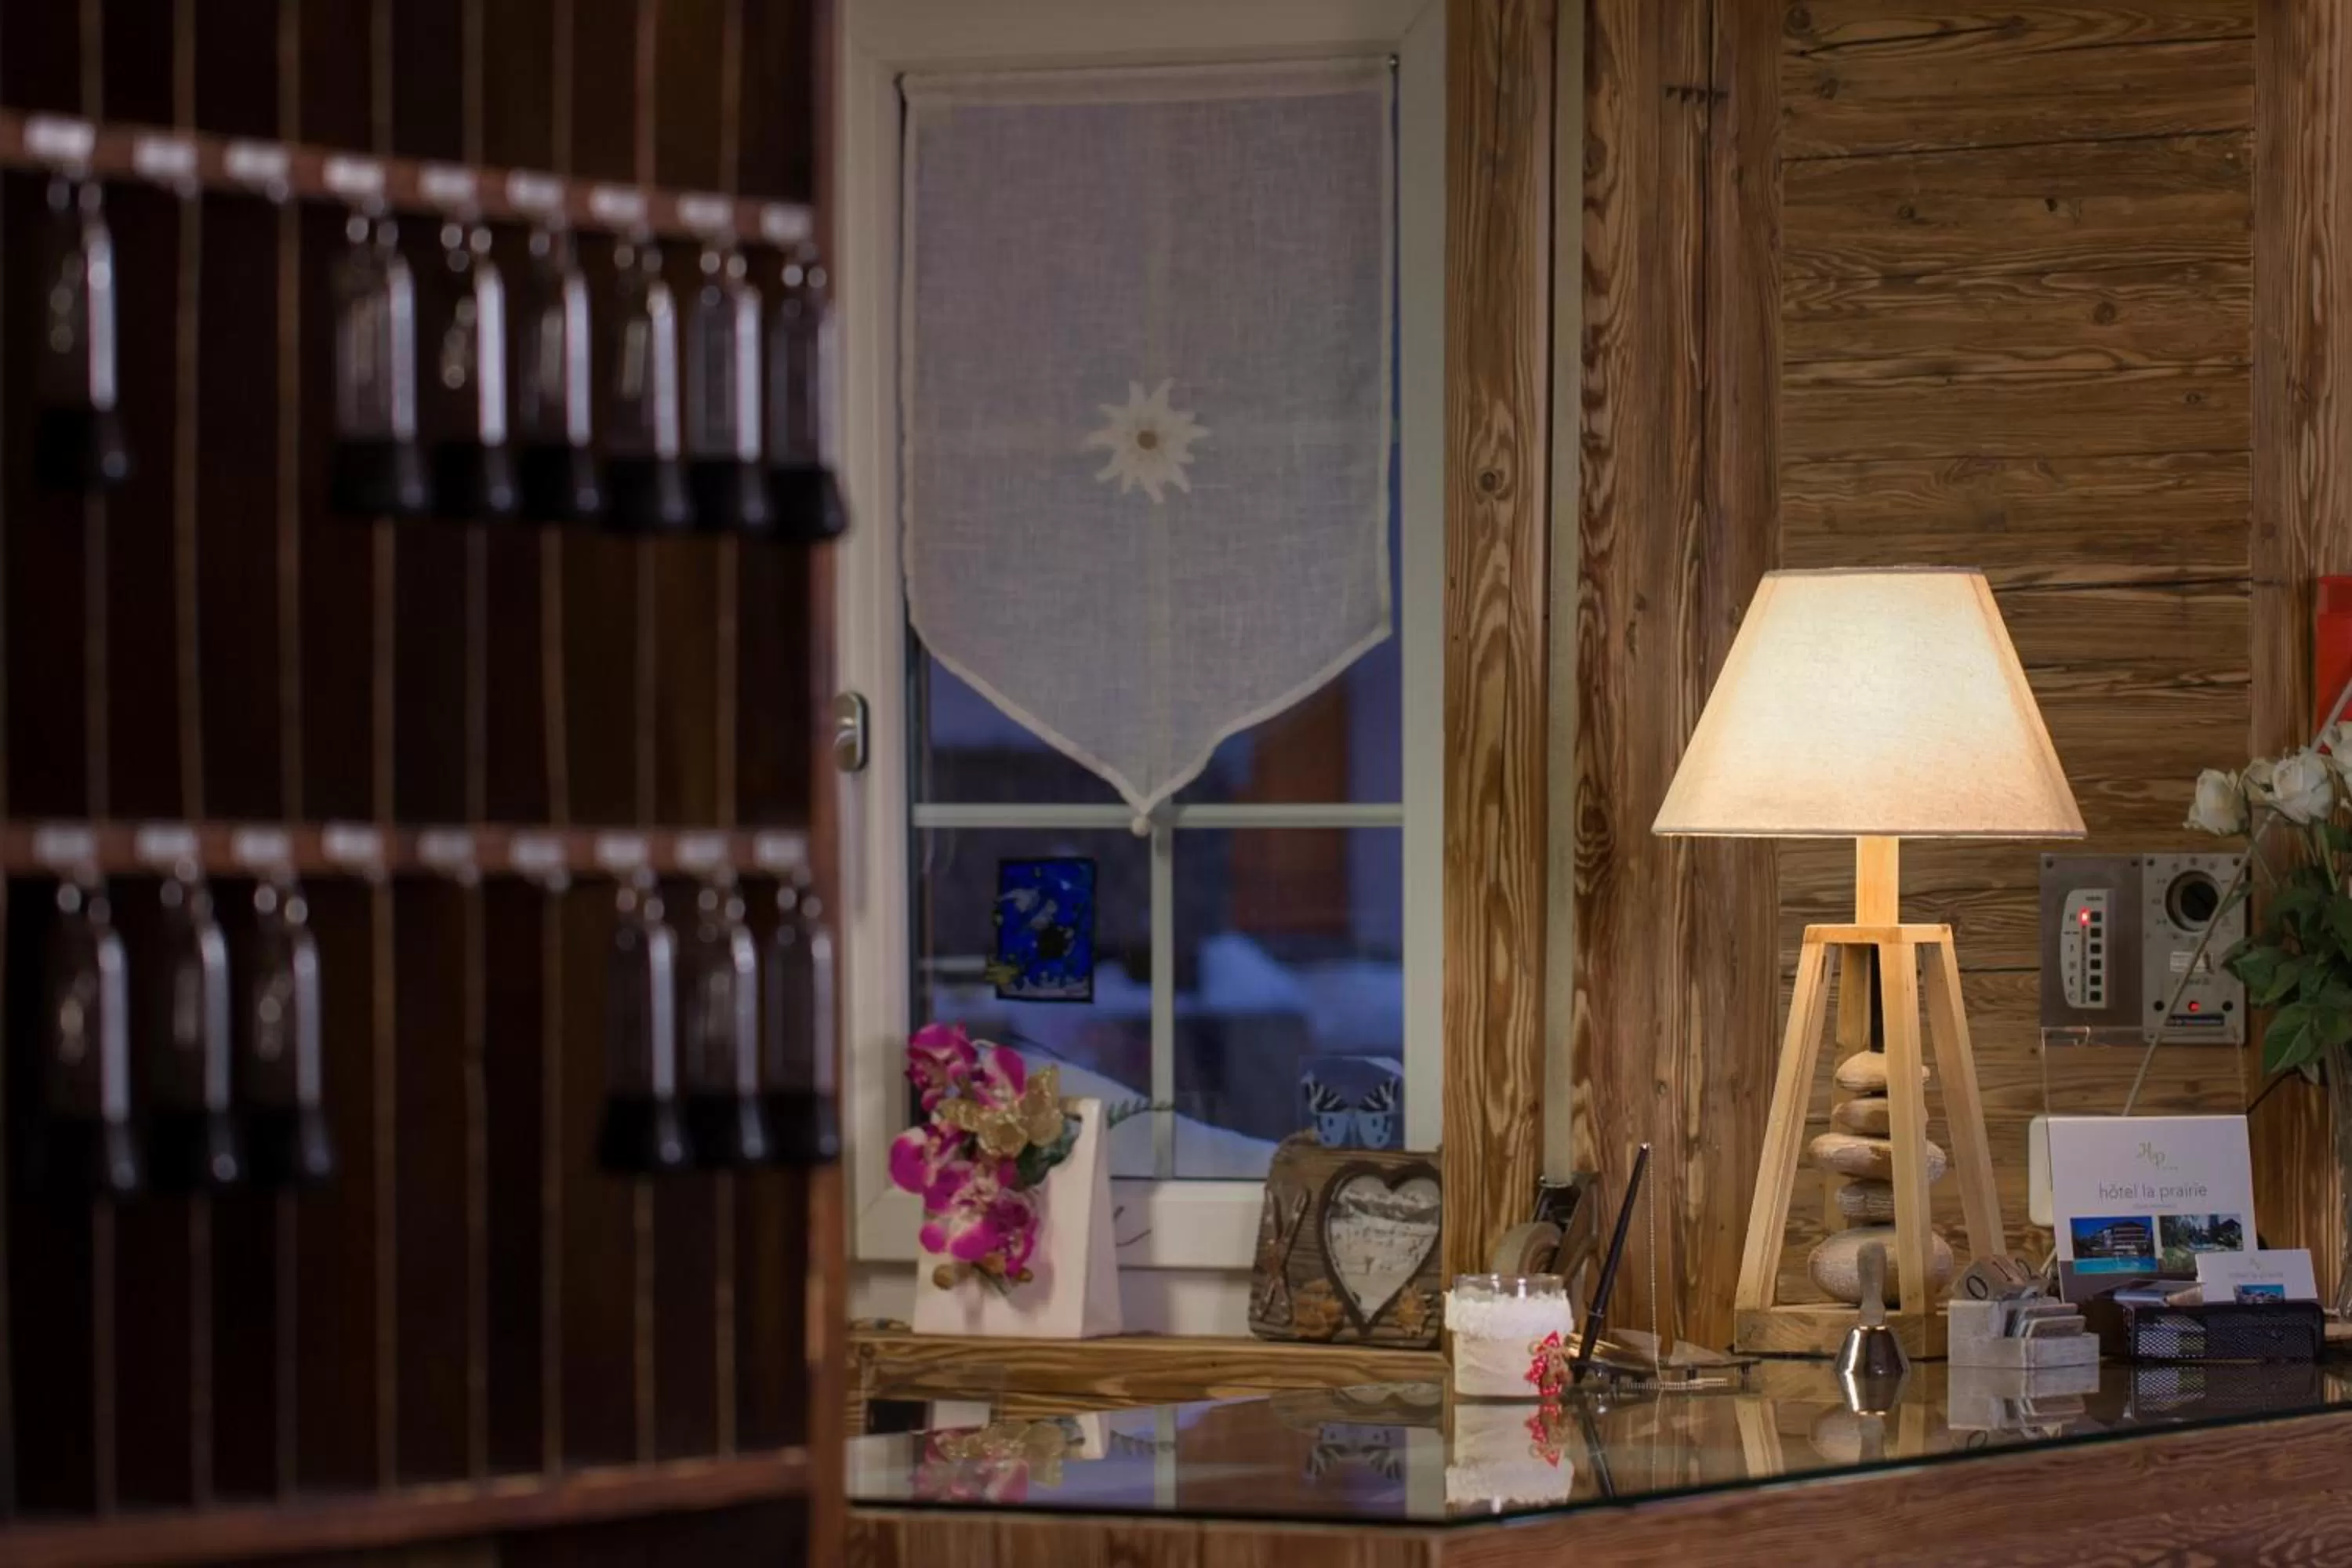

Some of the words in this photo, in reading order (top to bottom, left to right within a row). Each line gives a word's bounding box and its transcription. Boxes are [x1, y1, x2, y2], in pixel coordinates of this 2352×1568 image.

[2099, 1181, 2138, 1200] hôtel
[2141, 1182, 2156, 1199] la
[2158, 1182, 2208, 1202] prairie
